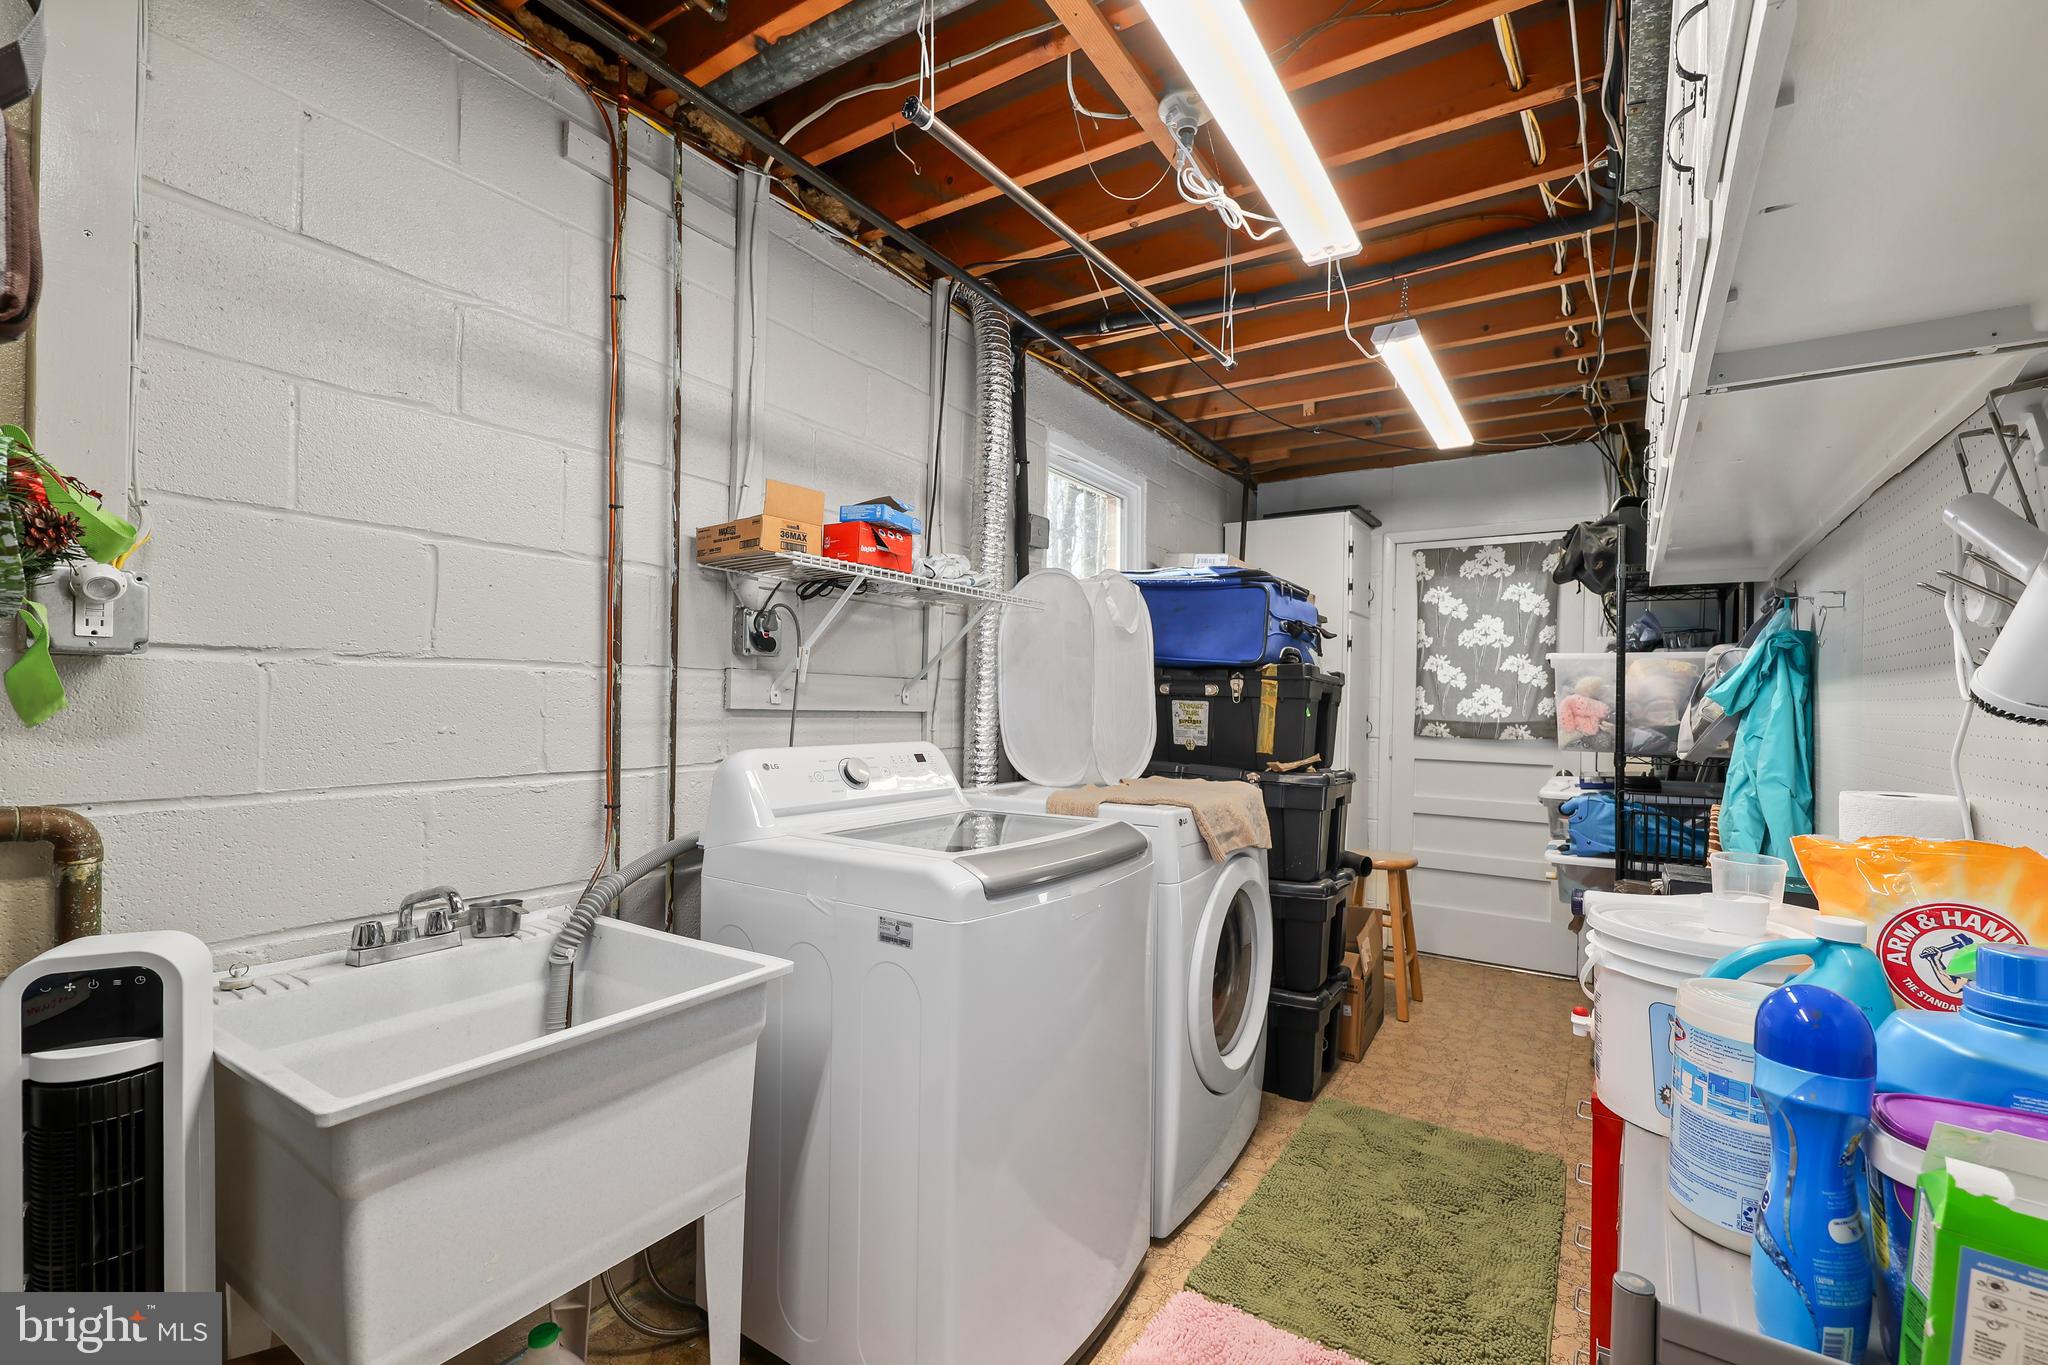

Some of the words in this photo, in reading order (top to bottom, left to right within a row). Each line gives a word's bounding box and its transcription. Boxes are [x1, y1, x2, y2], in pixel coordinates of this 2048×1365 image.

[780, 530, 808, 542] 36MAX
[1886, 921, 1921, 967] ARM
[1915, 913, 1941, 930] &
[1902, 976, 1918, 993] THE
